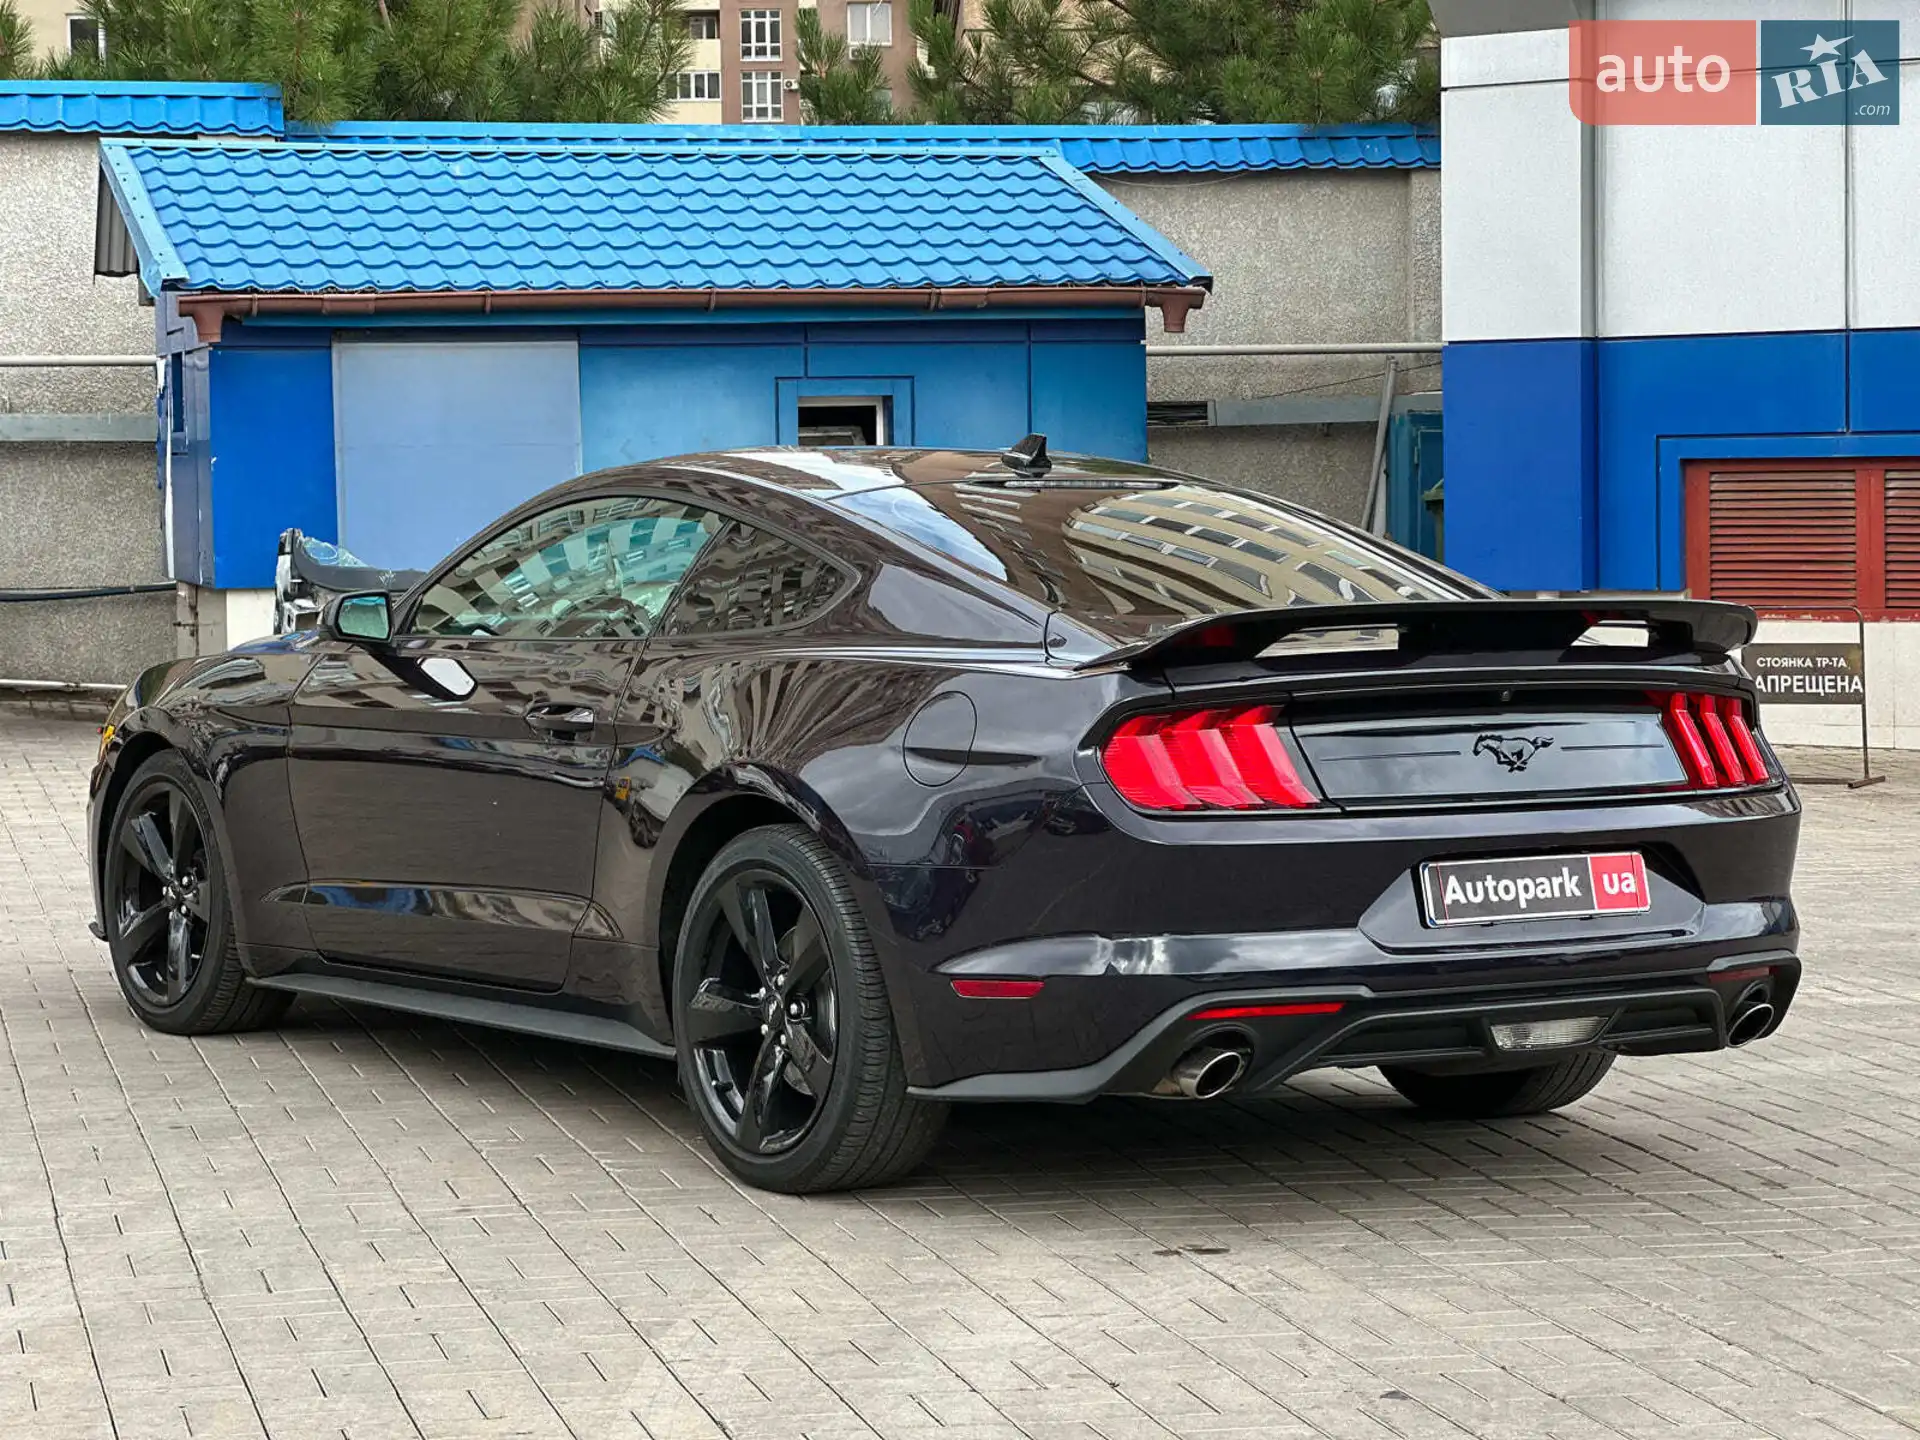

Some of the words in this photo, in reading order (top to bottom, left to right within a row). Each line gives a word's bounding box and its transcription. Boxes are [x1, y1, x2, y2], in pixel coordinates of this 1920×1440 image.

[1756, 657, 1813, 668] СТОЯНКА
[1816, 657, 1848, 668] ТР-ТА
[1755, 675, 1864, 696] АПРЕЩЕНА
[1444, 867, 1582, 909] Autopark
[1602, 871, 1637, 895] ua
